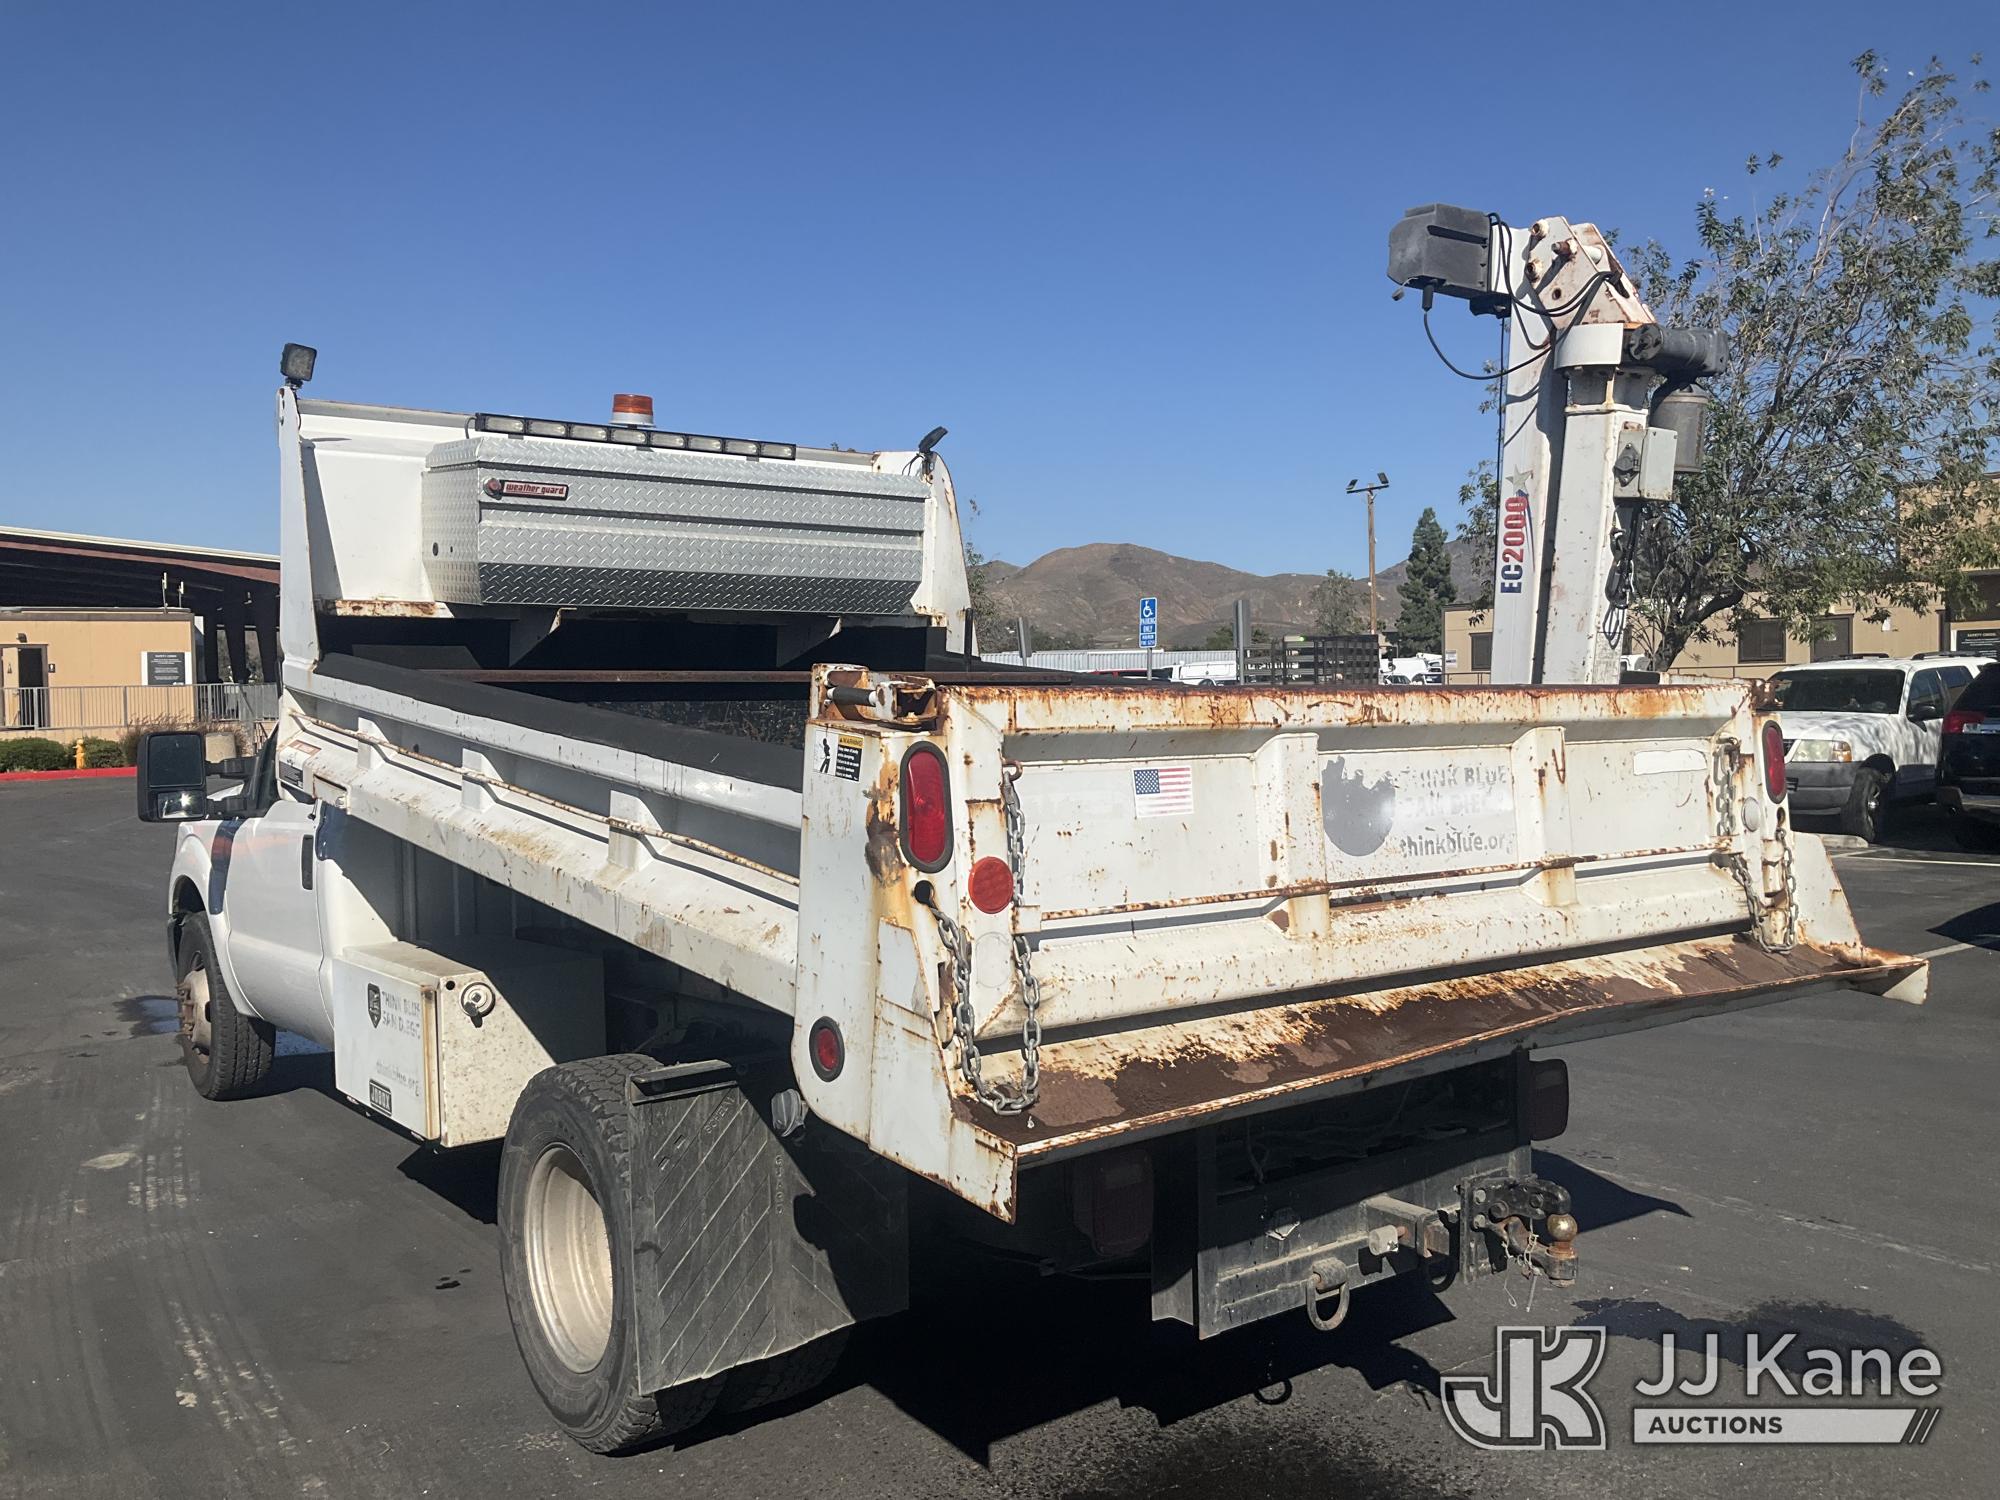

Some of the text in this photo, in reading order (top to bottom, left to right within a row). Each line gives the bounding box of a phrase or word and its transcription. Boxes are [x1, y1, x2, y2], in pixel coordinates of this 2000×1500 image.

[506, 483, 564, 495] weather guard
[1500, 496, 1528, 593] EC2000
[1464, 765, 1507, 788] BLUE
